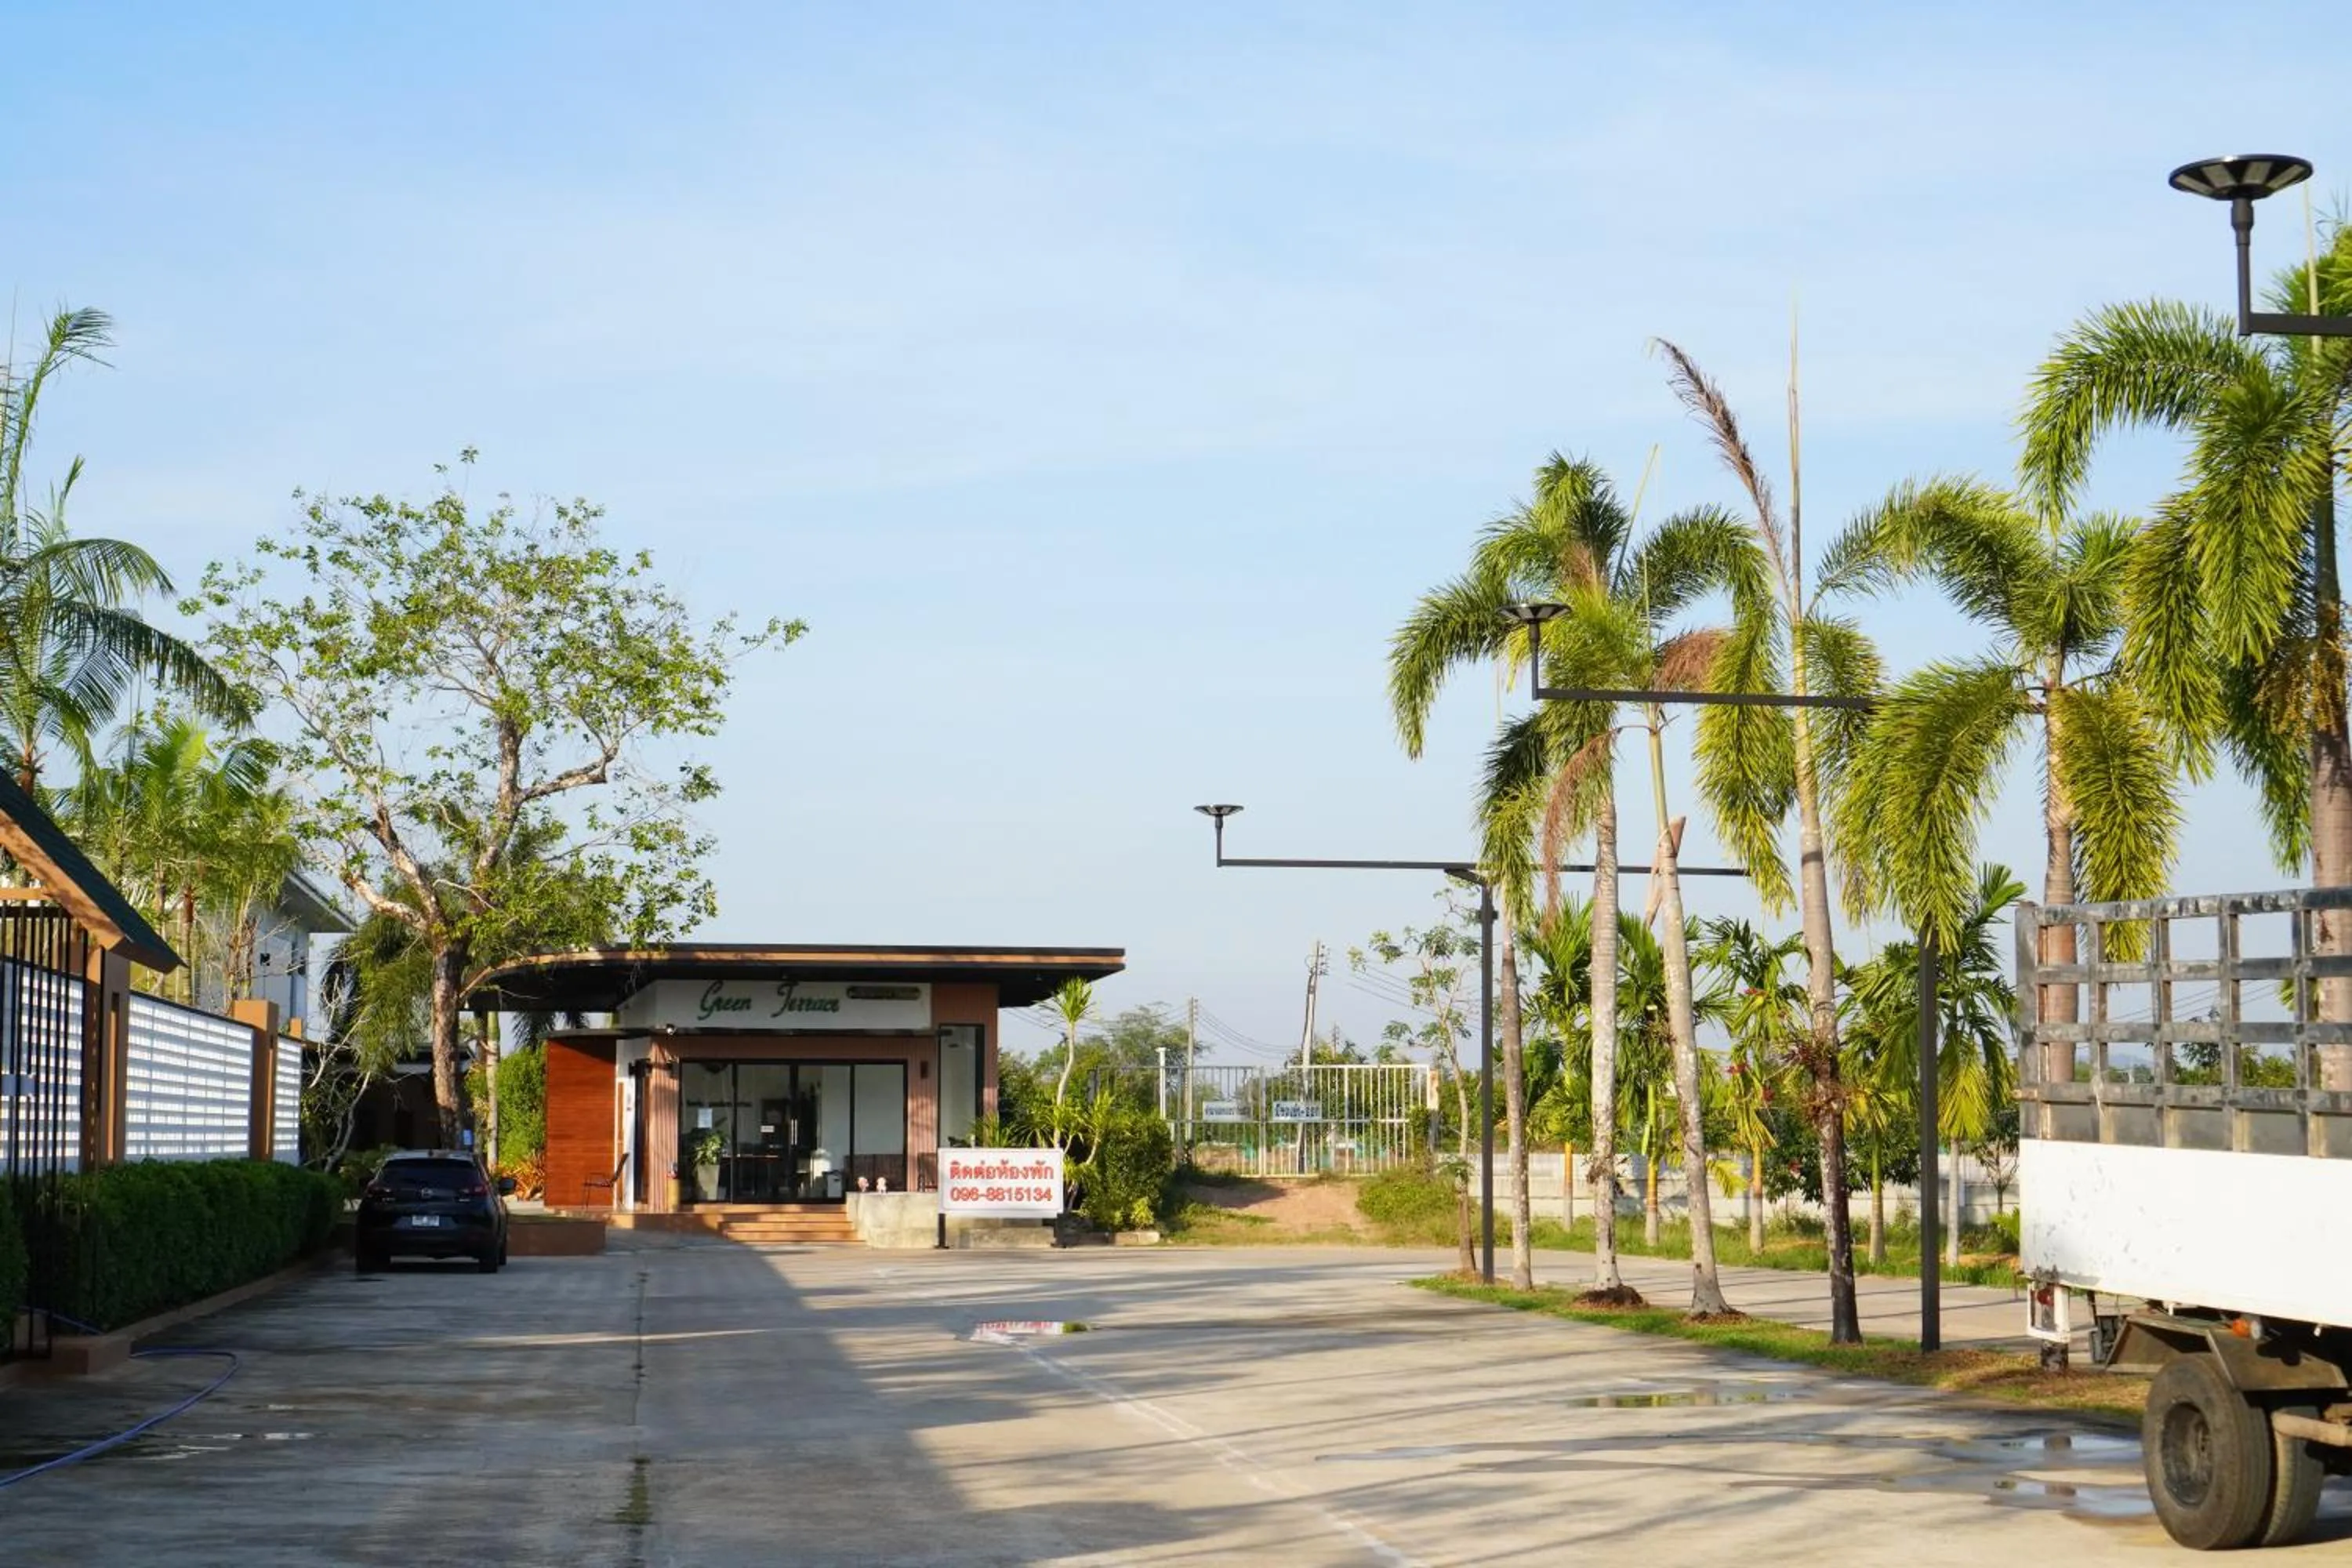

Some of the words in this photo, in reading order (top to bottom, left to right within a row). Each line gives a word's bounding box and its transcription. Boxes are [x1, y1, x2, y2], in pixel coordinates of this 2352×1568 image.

[697, 980, 752, 1021] Green
[770, 981, 840, 1018] Terrace
[949, 1159, 1054, 1180] ติดต่อห้องพัก
